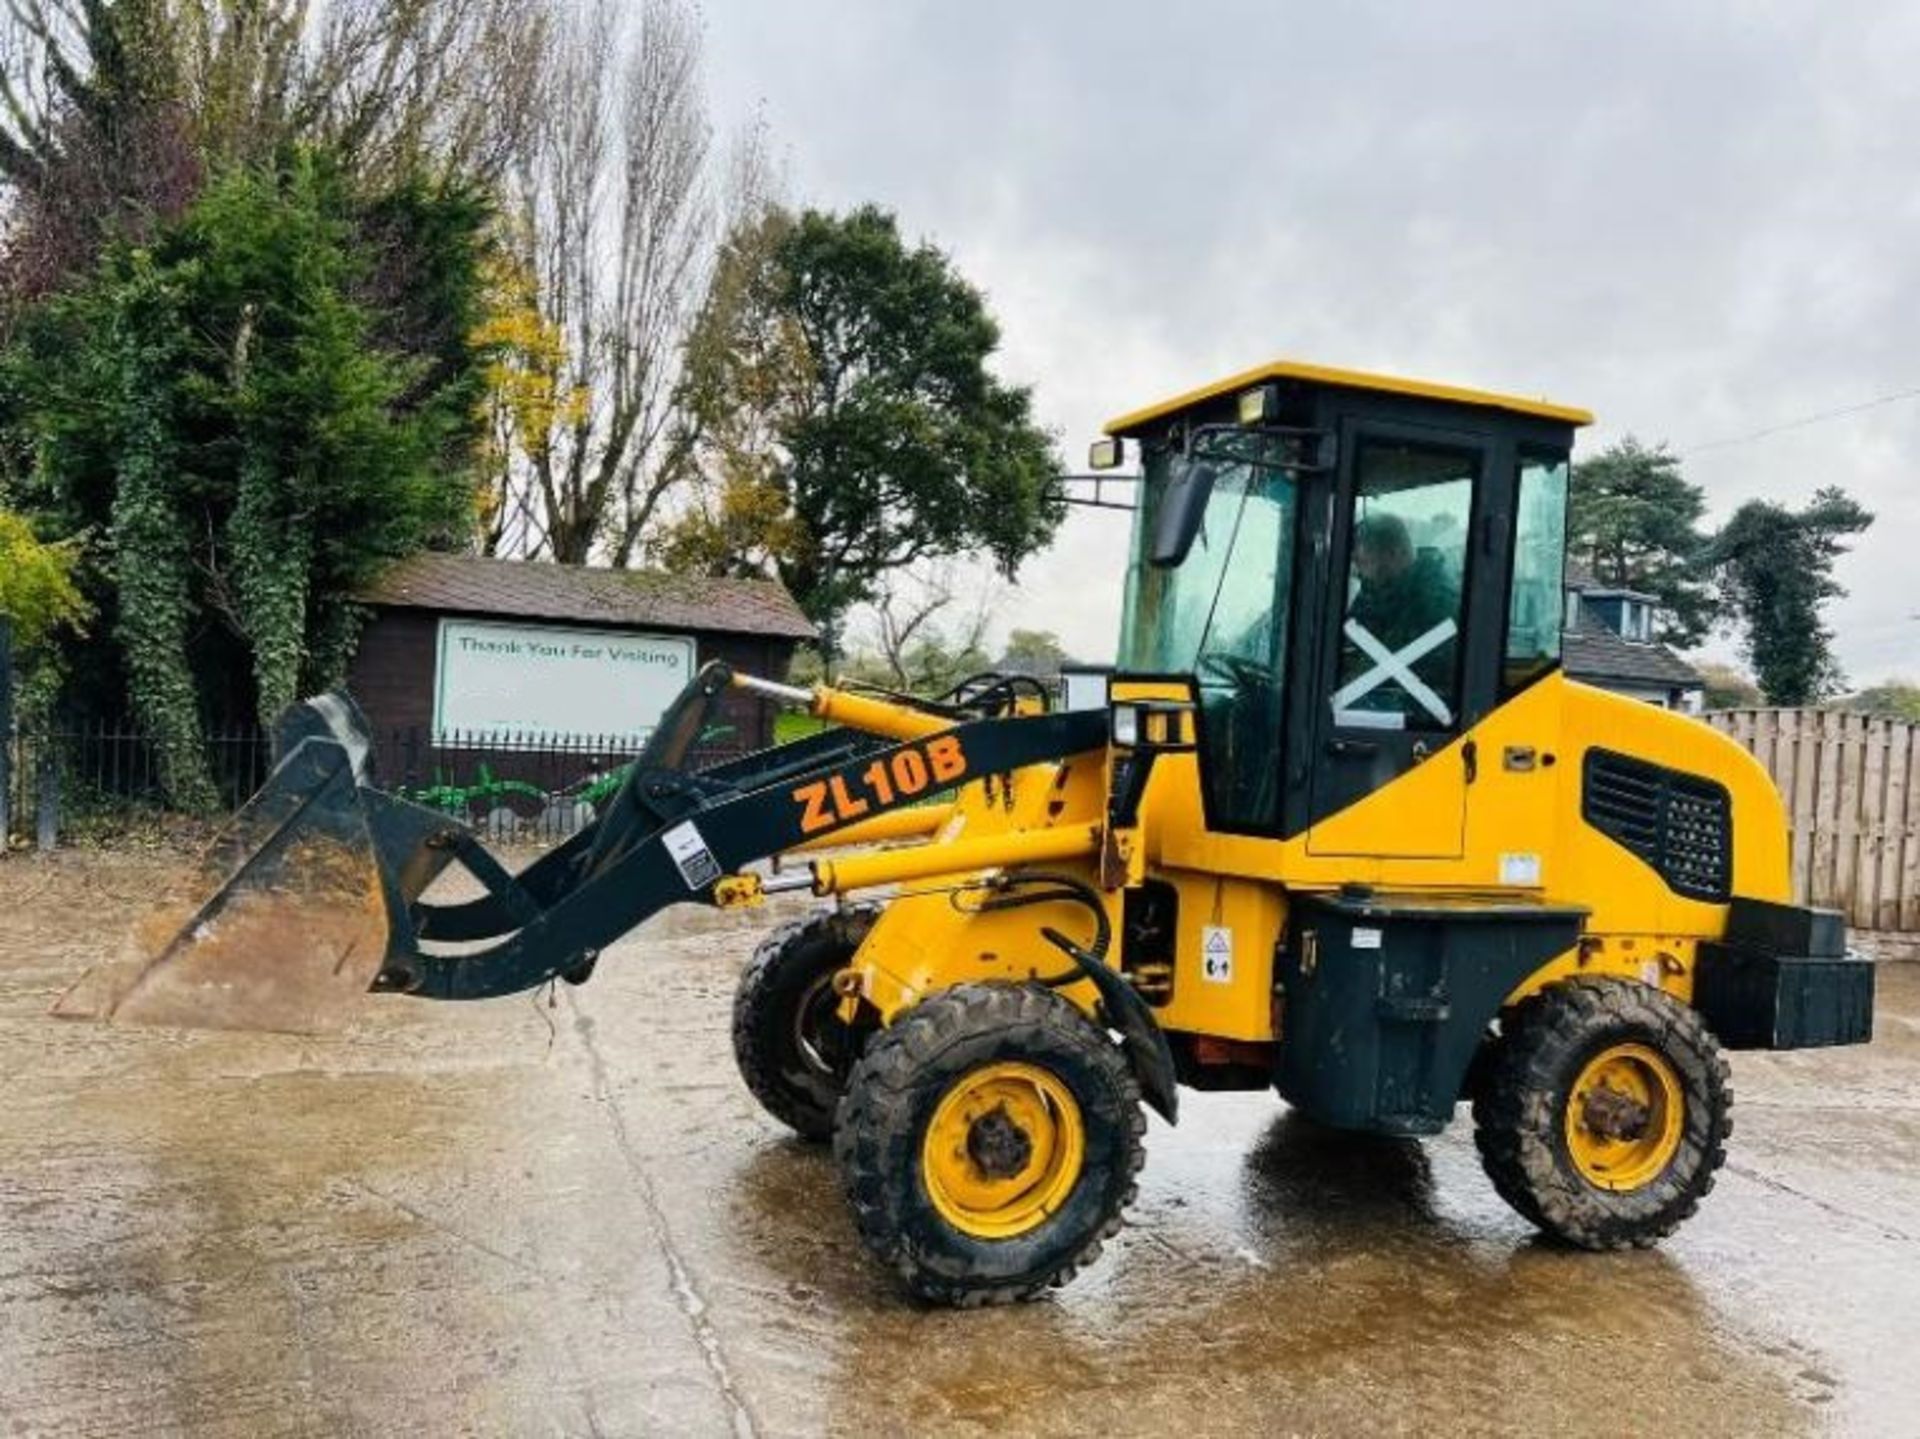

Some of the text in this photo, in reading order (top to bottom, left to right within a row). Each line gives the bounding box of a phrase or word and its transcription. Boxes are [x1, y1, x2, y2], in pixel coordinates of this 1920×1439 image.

[459, 636, 679, 667] Thank You For Visiting
[792, 734, 968, 833] ZL10B
